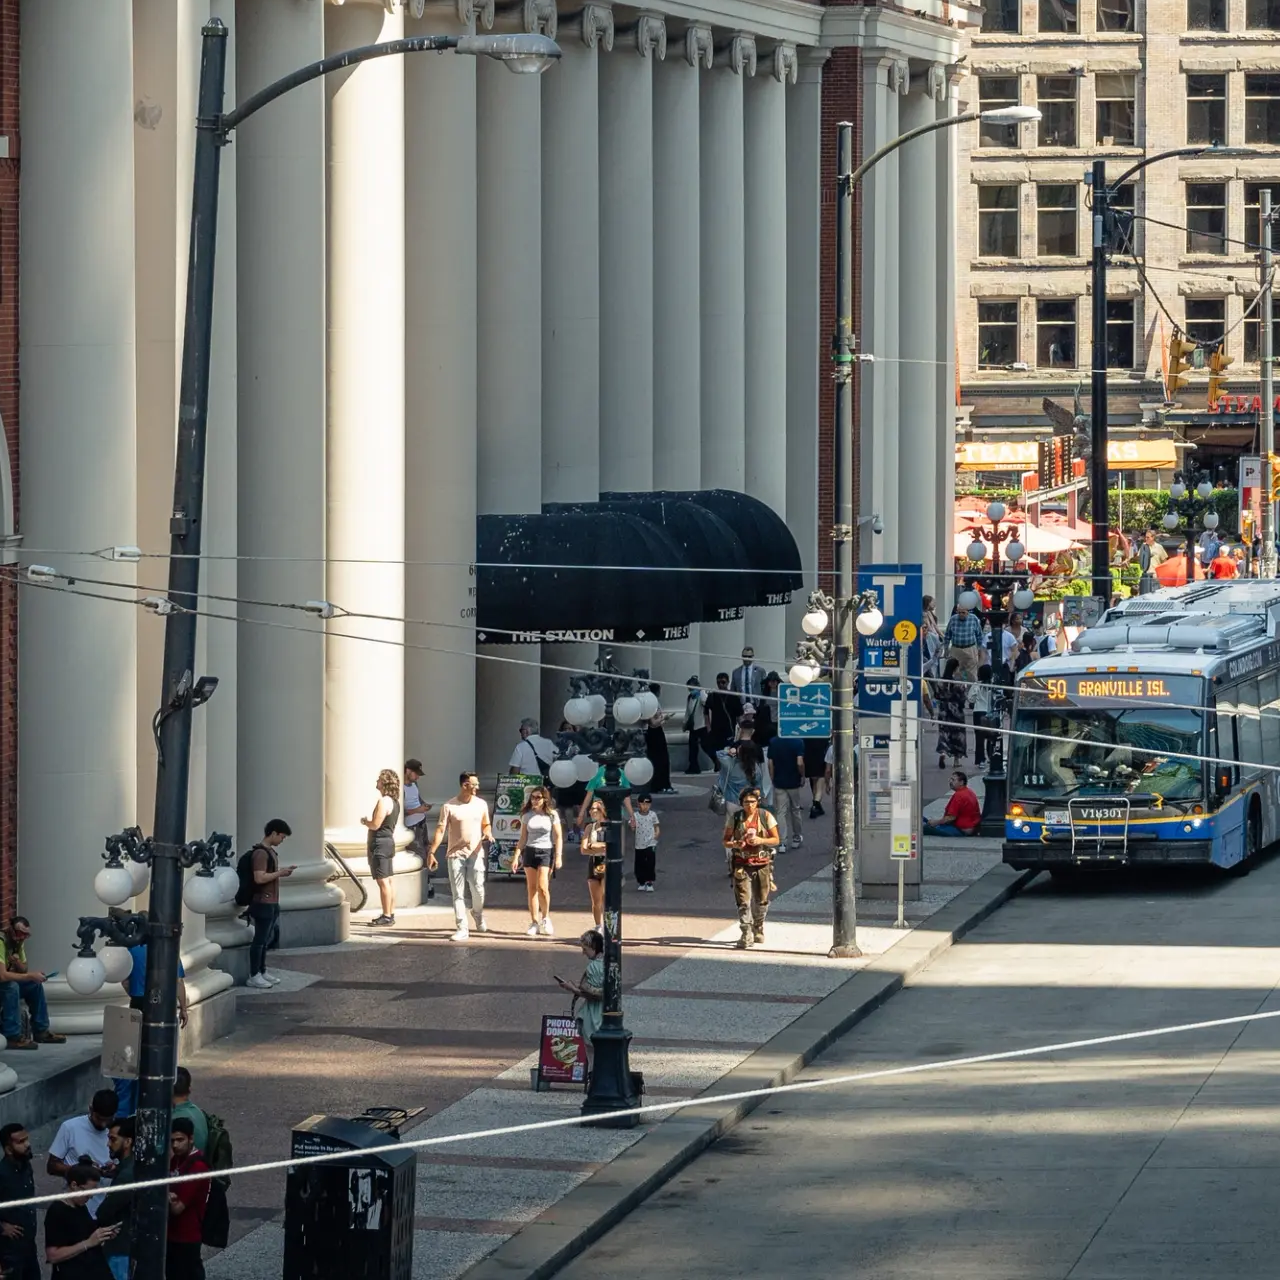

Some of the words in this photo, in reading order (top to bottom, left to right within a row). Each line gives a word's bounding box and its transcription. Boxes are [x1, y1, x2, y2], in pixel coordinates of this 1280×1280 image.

[766, 593, 783, 604] THE
[872, 575, 906, 616] T
[718, 607, 737, 620] THE
[511, 630, 541, 642] THE
[544, 628, 614, 642] STATION
[663, 626, 681, 639] THE
[902, 629, 909, 640] 2
[1047, 679, 1067, 699] 50
[1078, 681, 1143, 696] GRANVILLE
[1146, 681, 1170, 696] ISL.
[1081, 808, 1122, 818] V18301
